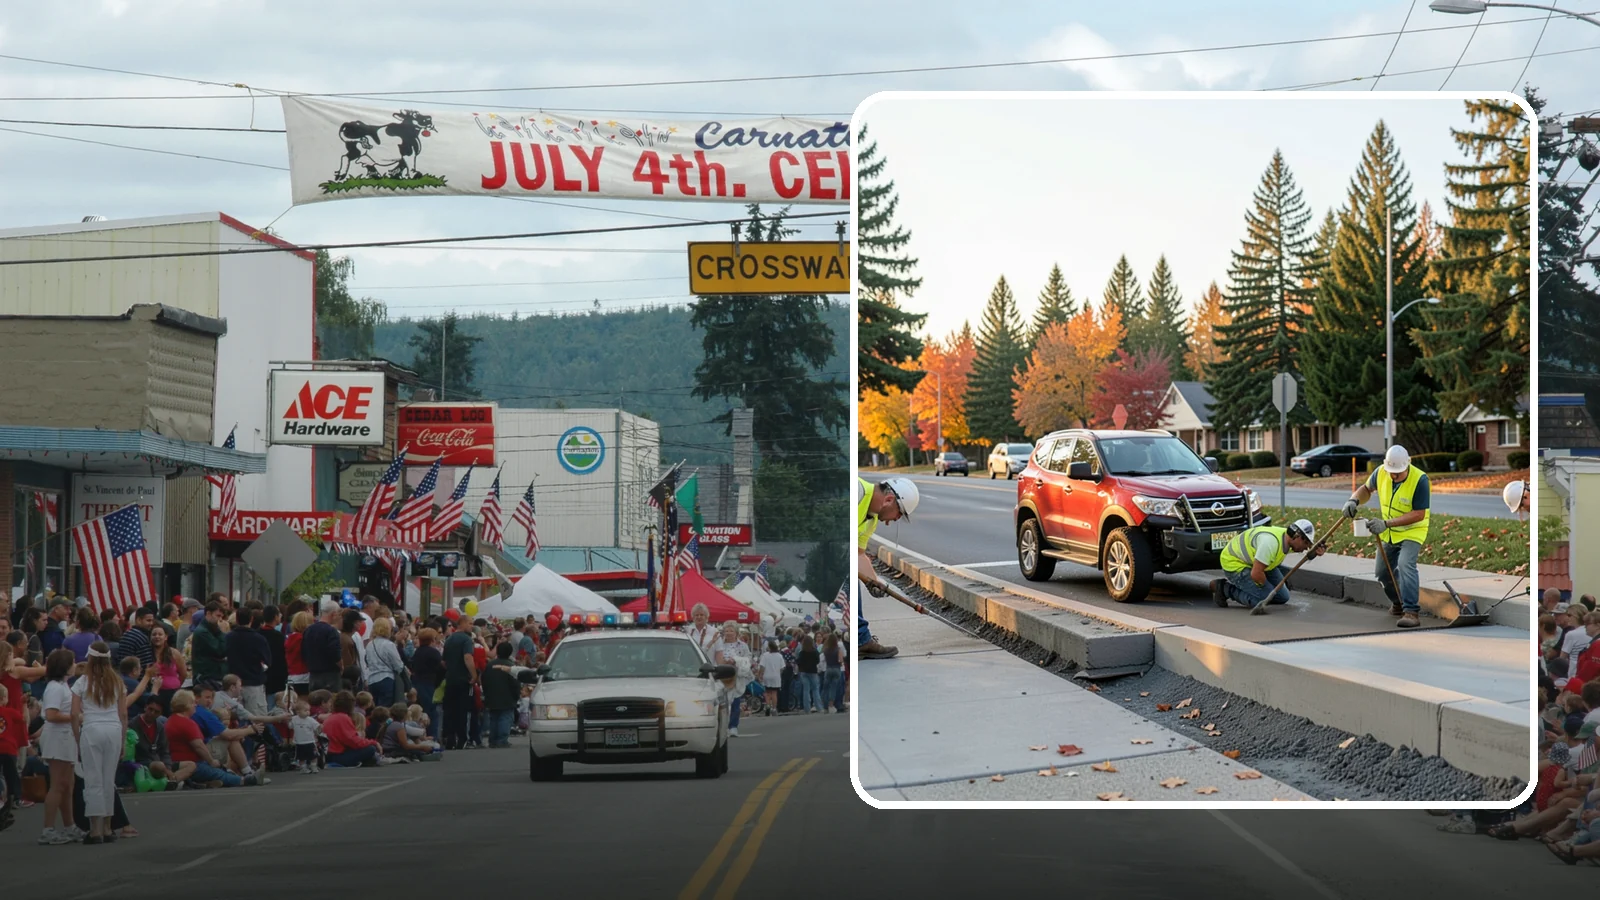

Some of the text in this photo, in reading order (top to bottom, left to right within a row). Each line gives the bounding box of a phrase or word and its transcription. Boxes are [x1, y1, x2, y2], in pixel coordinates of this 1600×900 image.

[695, 121, 849, 149] Carnat
[481, 141, 605, 192] JULY
[632, 150, 746, 198] 4th.
[697, 254, 850, 280] CROSSWA
[282, 380, 374, 420] ACE
[405, 409, 485, 422] CEDAR LOG
[283, 421, 371, 437] Hardware
[353, 467, 387, 480] Simpl
[83, 484, 155, 495] St. Vincent de Paul
[213, 516, 331, 535] HARDARE
[688, 526, 742, 535] CRNATION
[699, 535, 730, 543] GLASS
